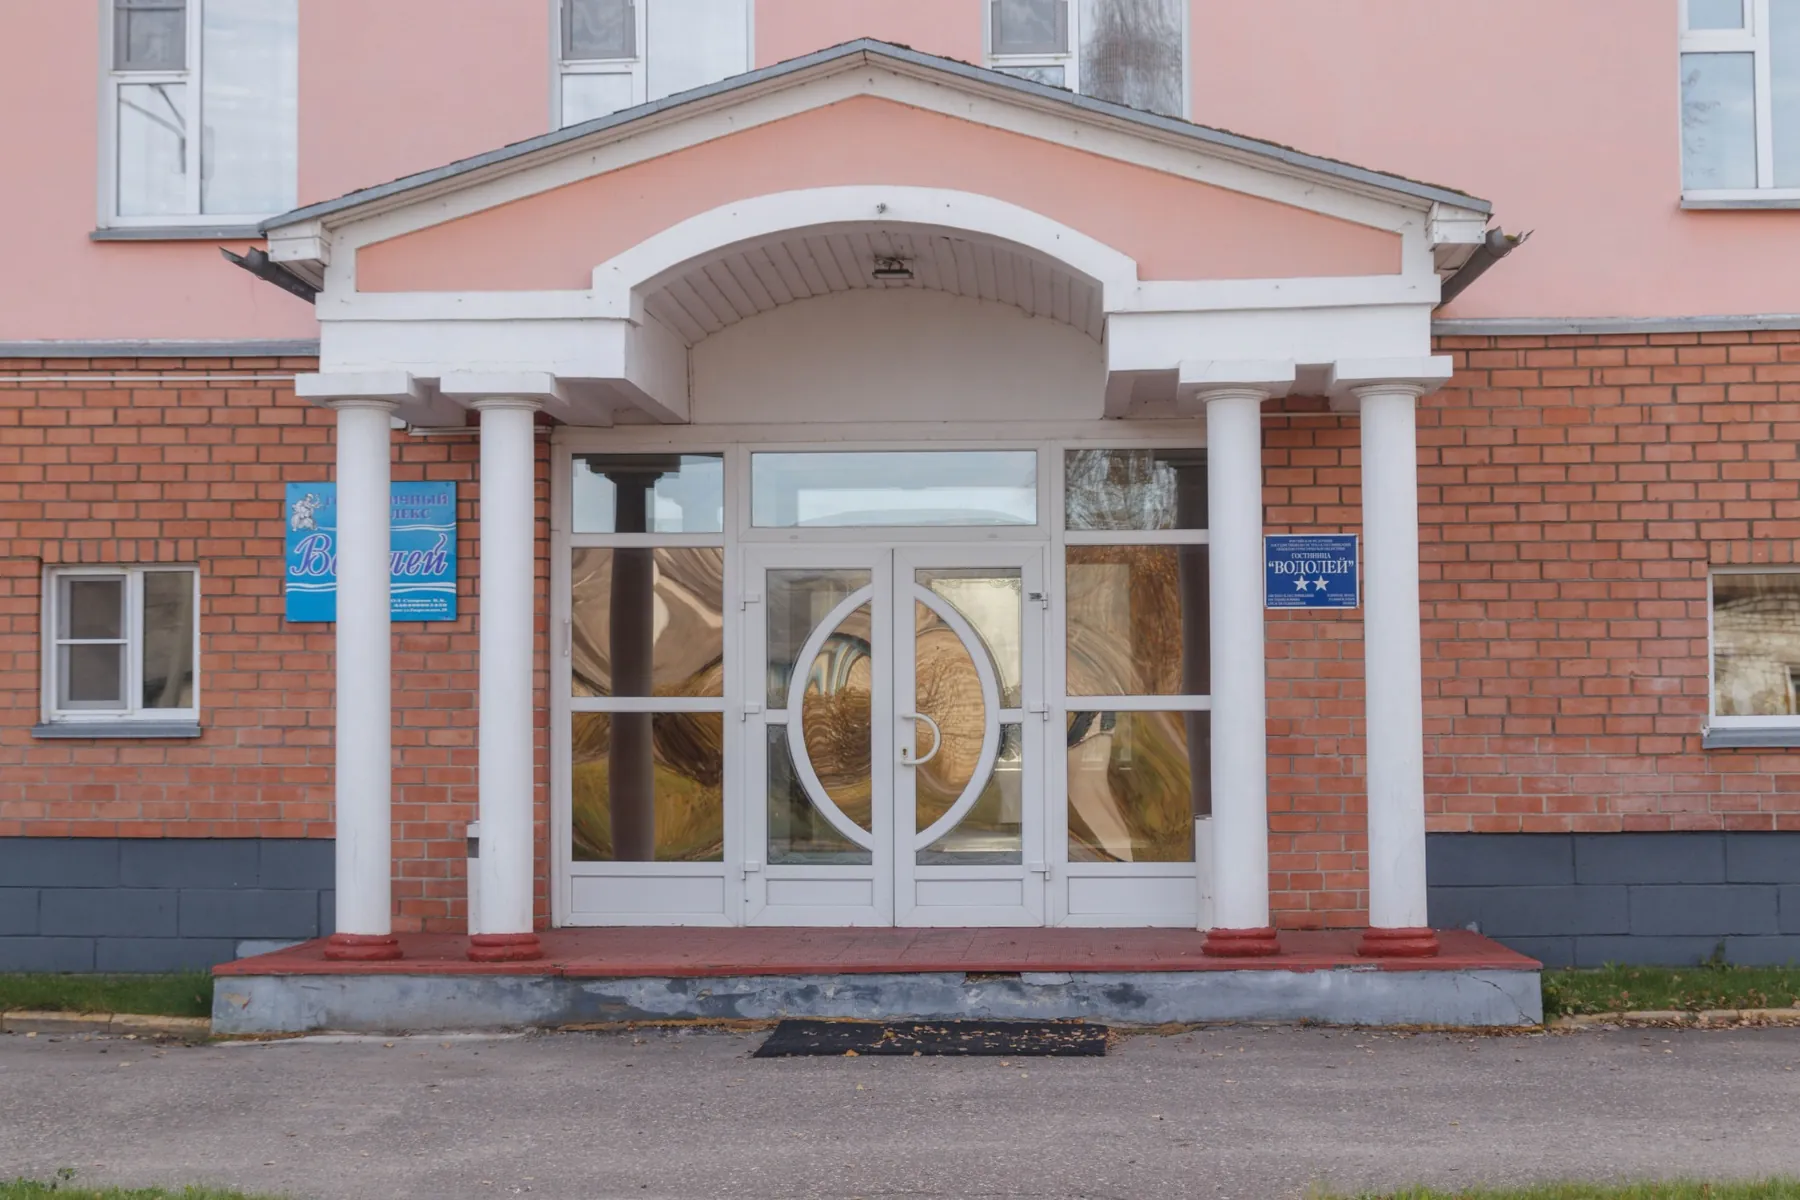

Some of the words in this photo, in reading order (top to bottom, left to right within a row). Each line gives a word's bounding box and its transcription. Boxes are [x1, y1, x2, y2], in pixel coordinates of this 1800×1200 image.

[325, 493, 448, 506] ГИЧНЫЙ
[289, 533, 448, 576] Влей
[1291, 552, 1332, 560] ГОСТИНИЦА
